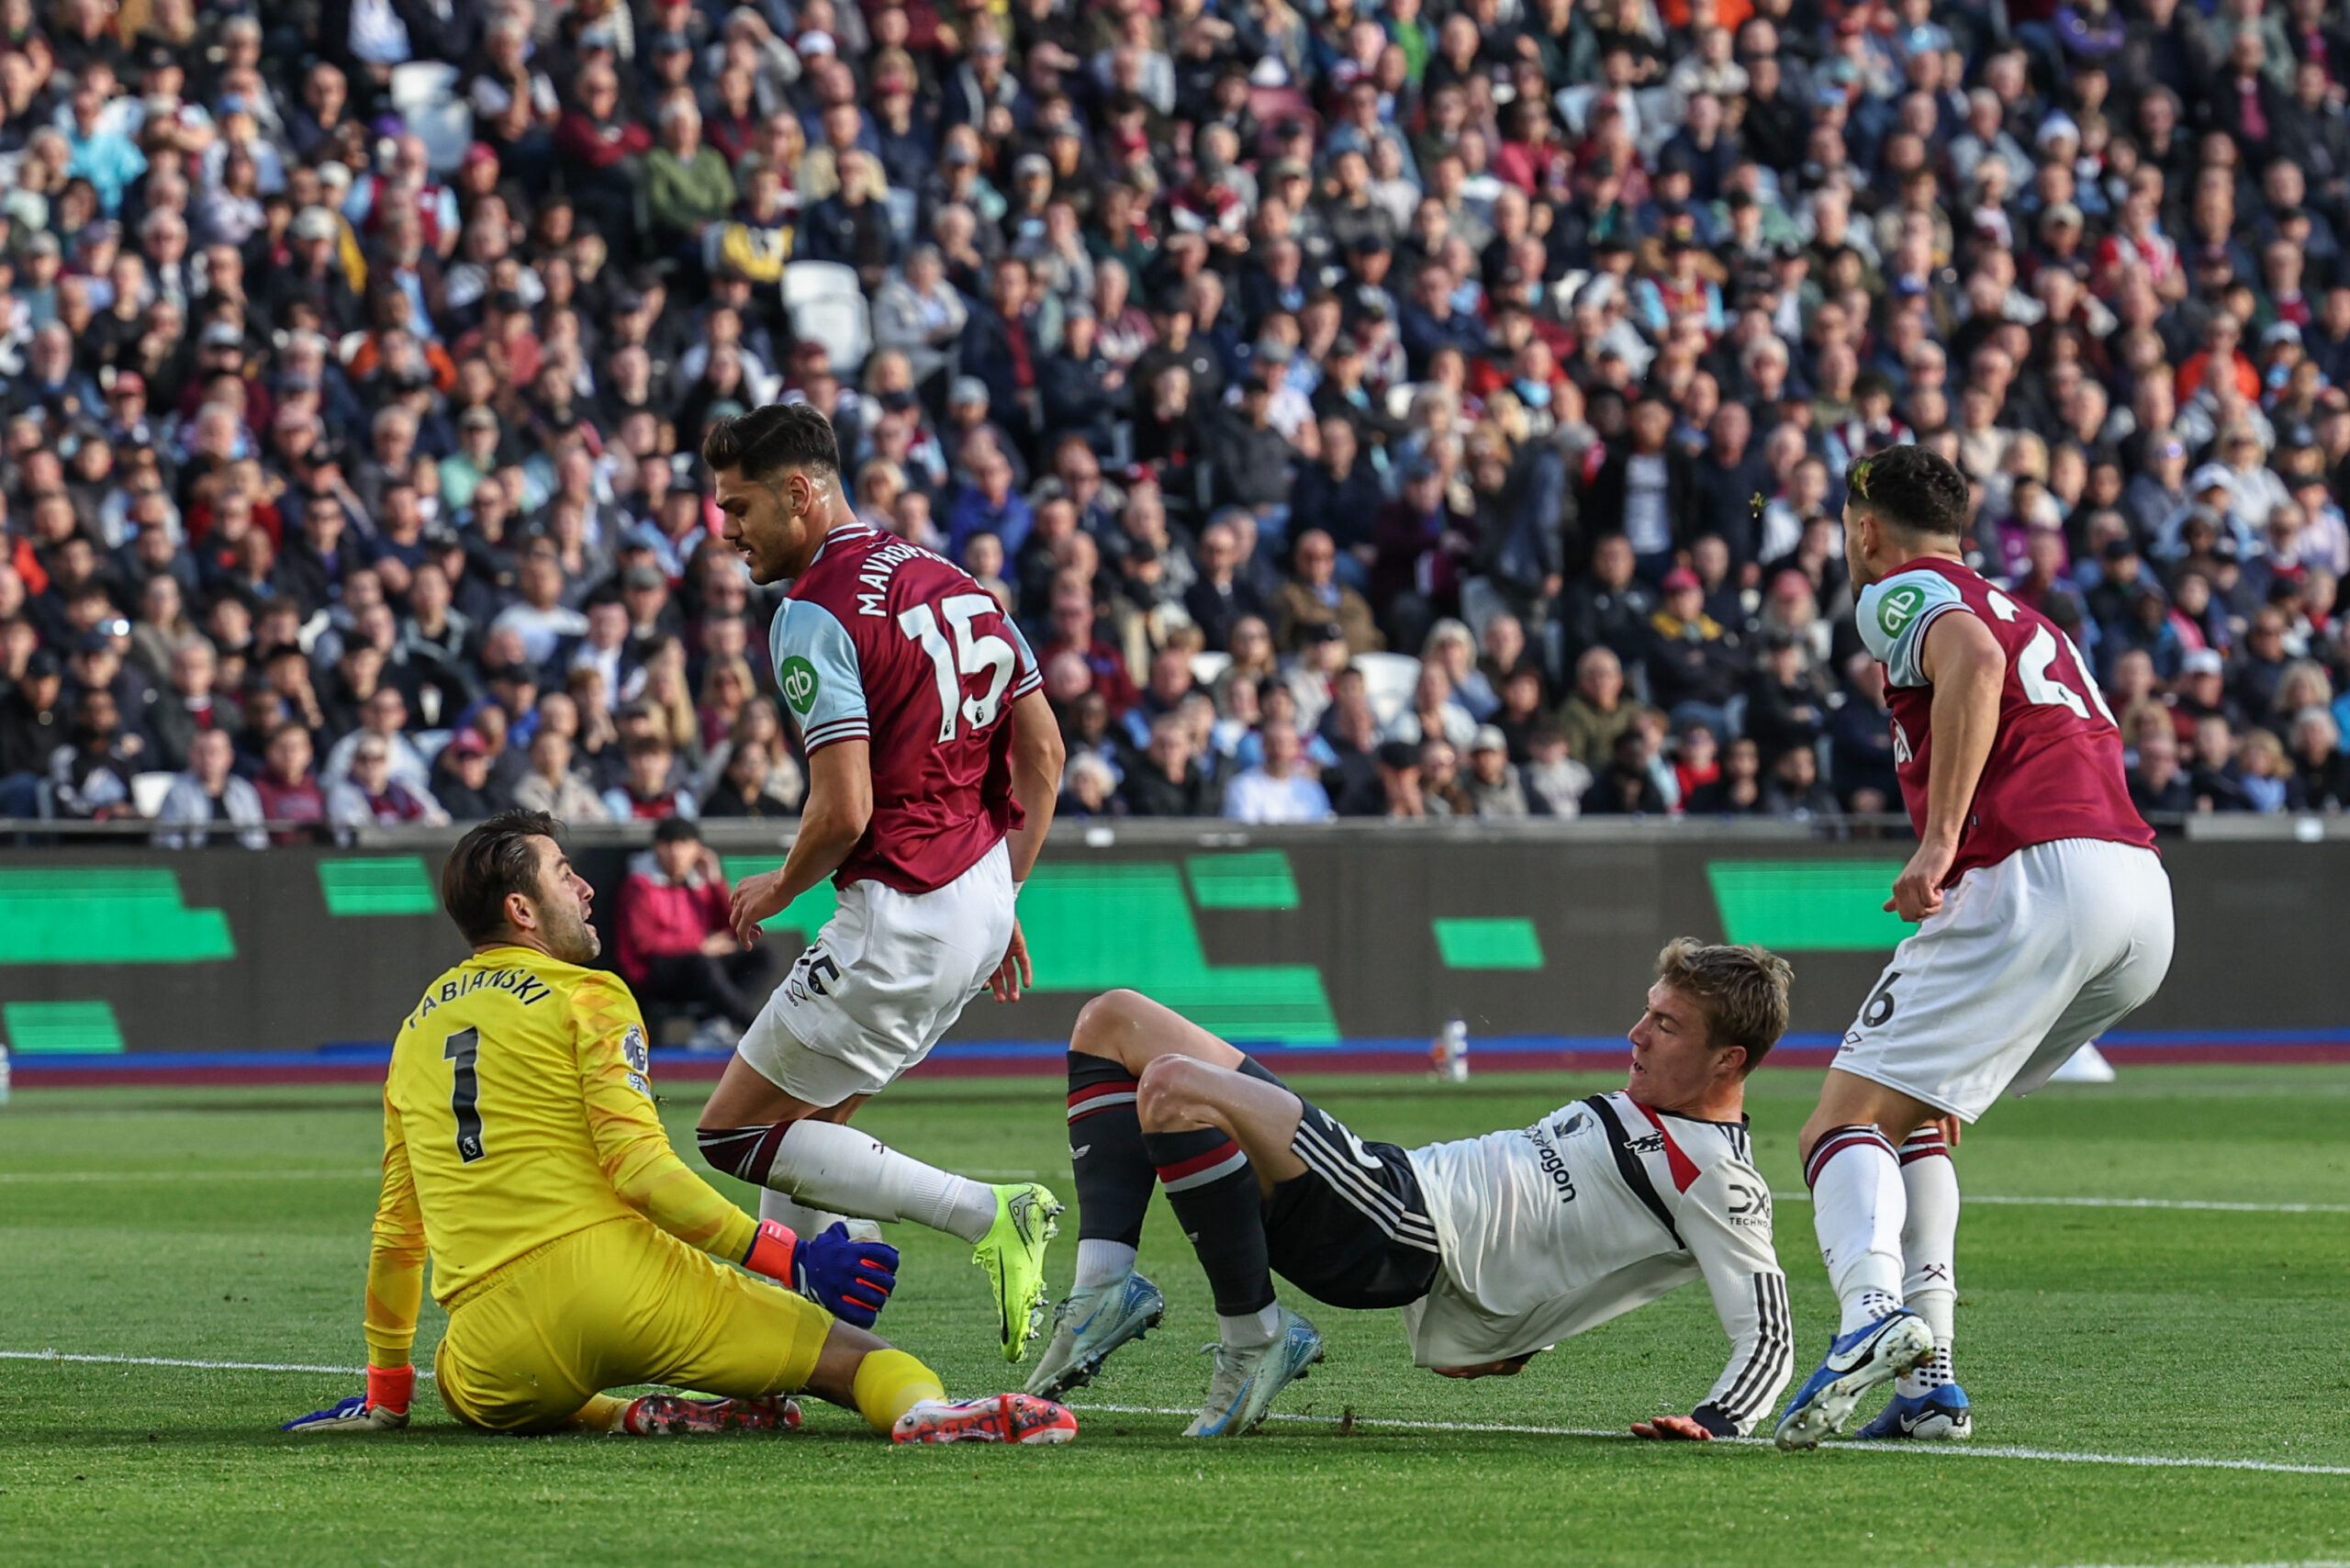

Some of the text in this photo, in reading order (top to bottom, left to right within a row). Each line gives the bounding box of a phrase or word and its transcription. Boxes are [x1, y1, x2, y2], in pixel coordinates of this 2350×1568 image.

[856, 543, 985, 617] MAVROP
[897, 593, 1016, 744] 15
[1986, 589, 2119, 728] 2
[443, 1025, 486, 1164] 1
